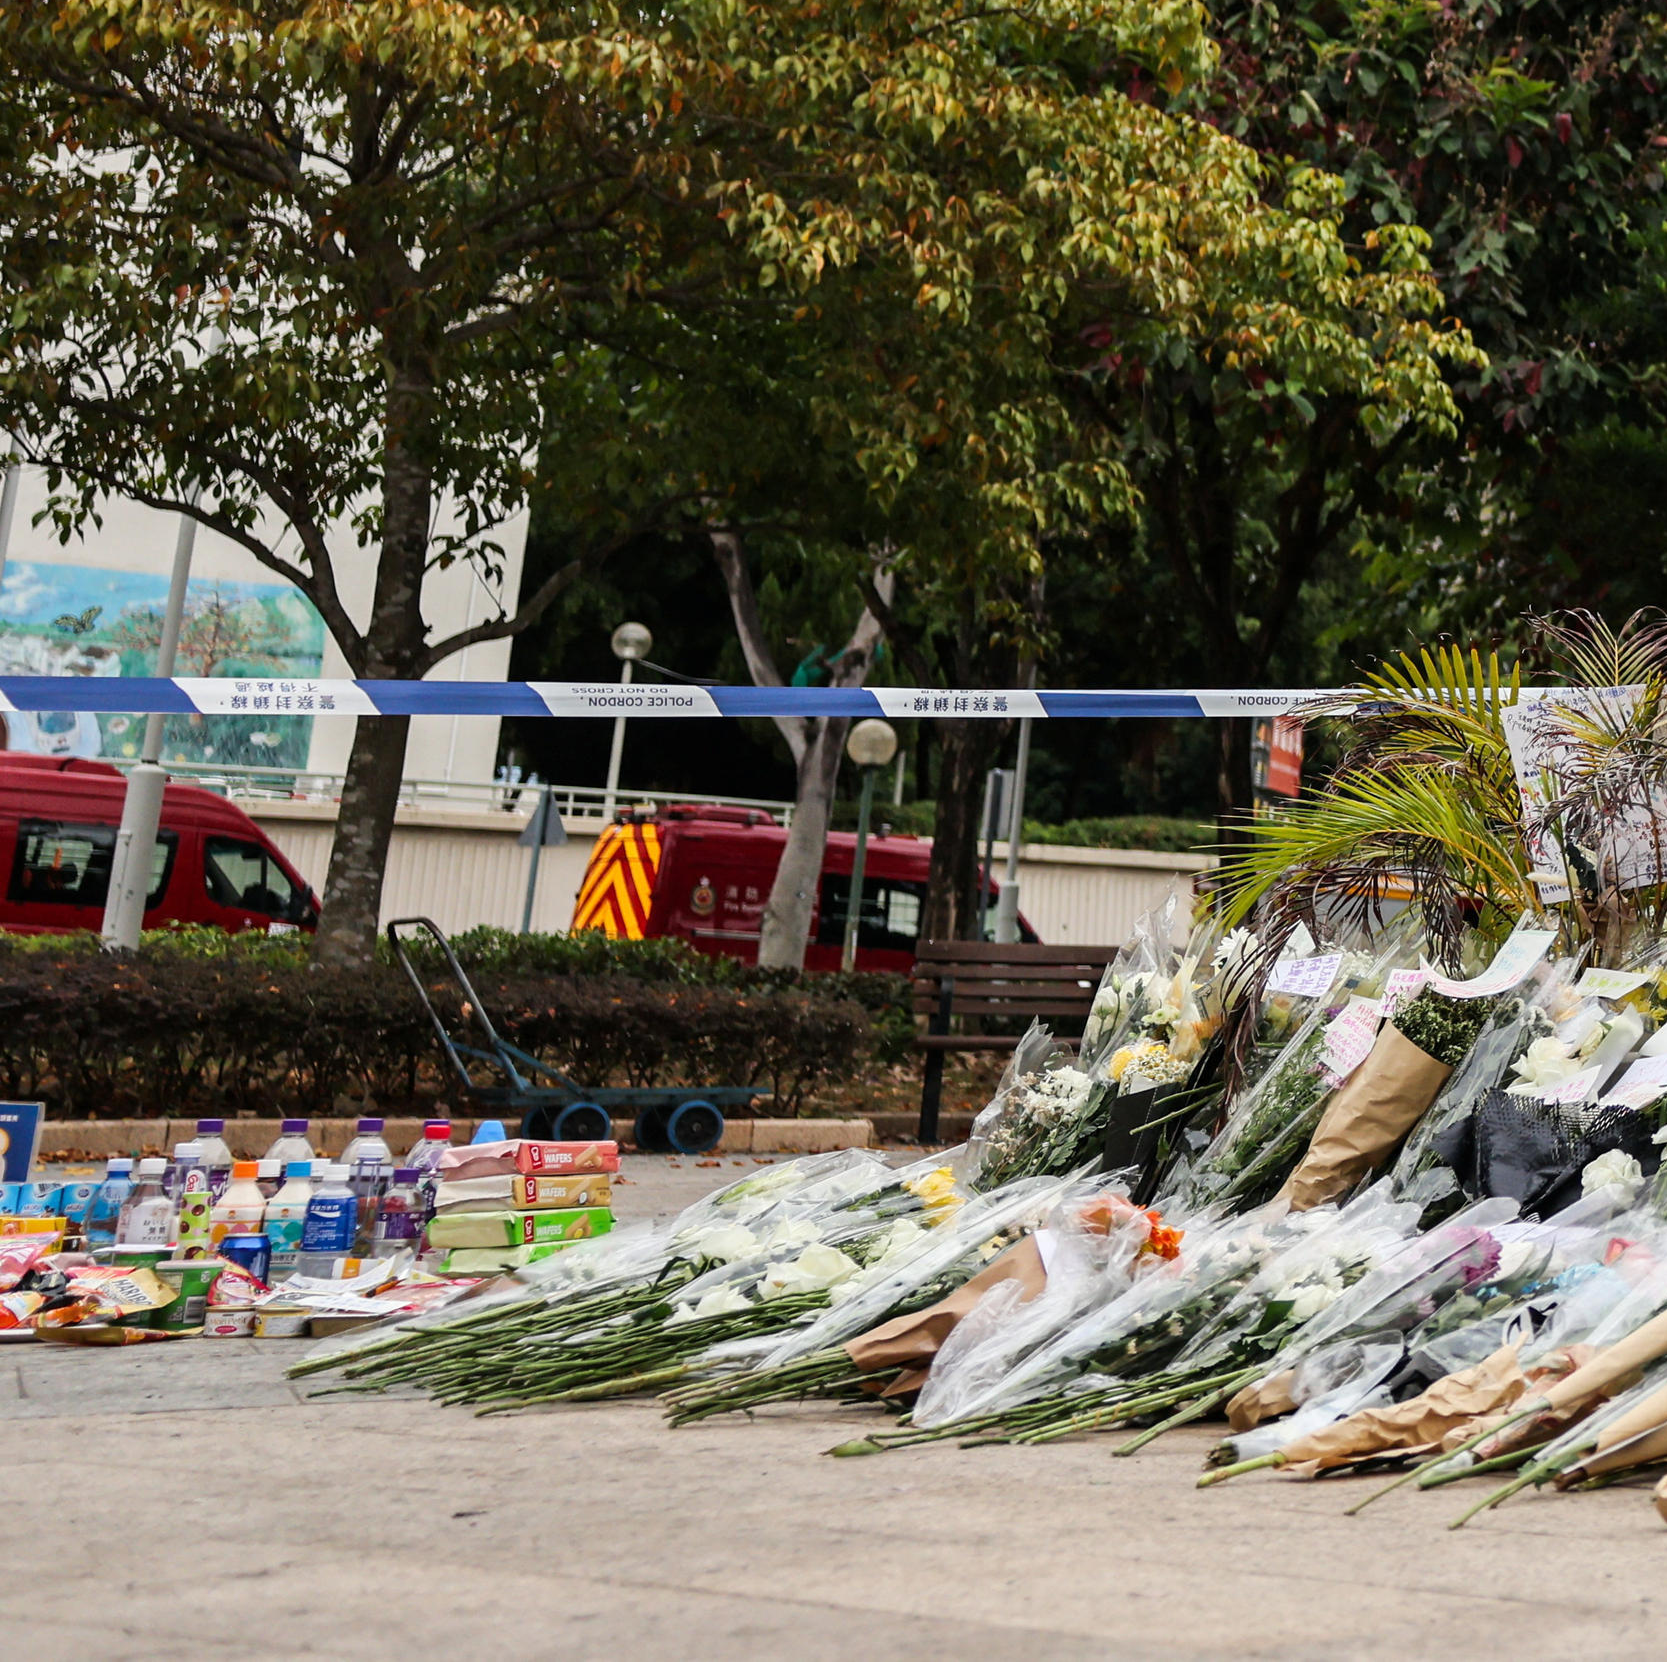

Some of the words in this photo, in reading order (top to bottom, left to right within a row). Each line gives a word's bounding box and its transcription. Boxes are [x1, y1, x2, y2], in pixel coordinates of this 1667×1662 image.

[648, 697, 693, 707] POLICE
[543, 1152, 573, 1165] WAFERS
[538, 1186, 567, 1198] WAFERS
[536, 1224, 563, 1236] WAFERS
